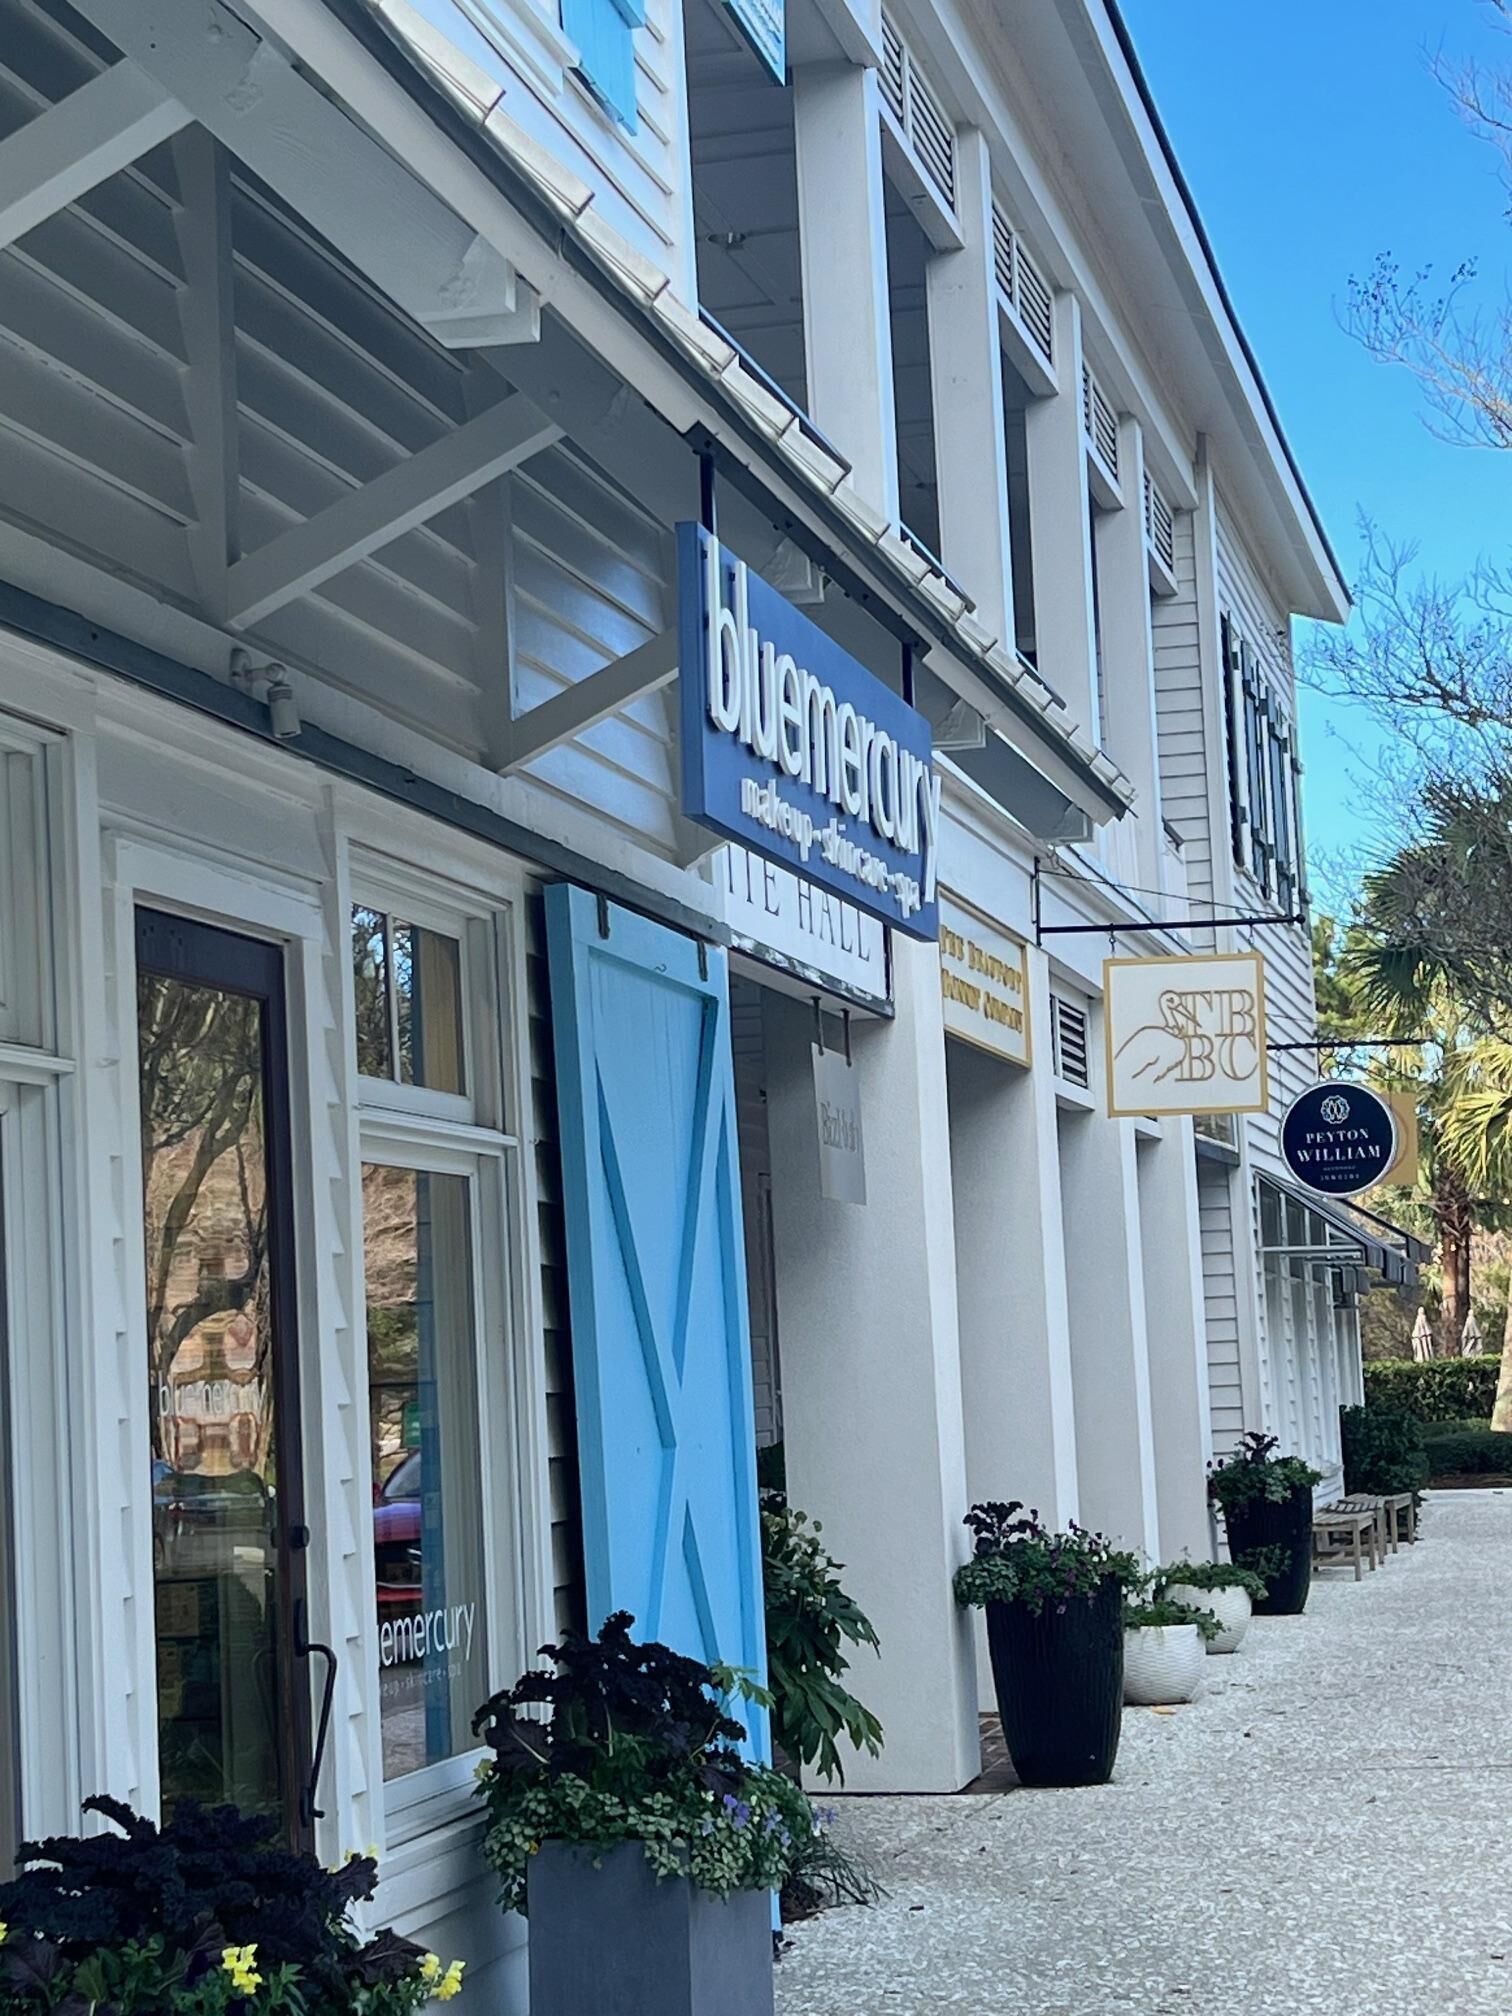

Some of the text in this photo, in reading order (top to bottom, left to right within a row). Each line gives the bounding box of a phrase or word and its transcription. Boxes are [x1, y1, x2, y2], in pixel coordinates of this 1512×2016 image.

[707, 533, 941, 903] bluemercury
[741, 777, 922, 919] makeup skincare spa
[797, 877, 872, 963] HALL
[1296, 1144, 1381, 1163] WILLIAM
[1305, 1127, 1370, 1145] PEYTON
[378, 1601, 476, 1667] emercury
